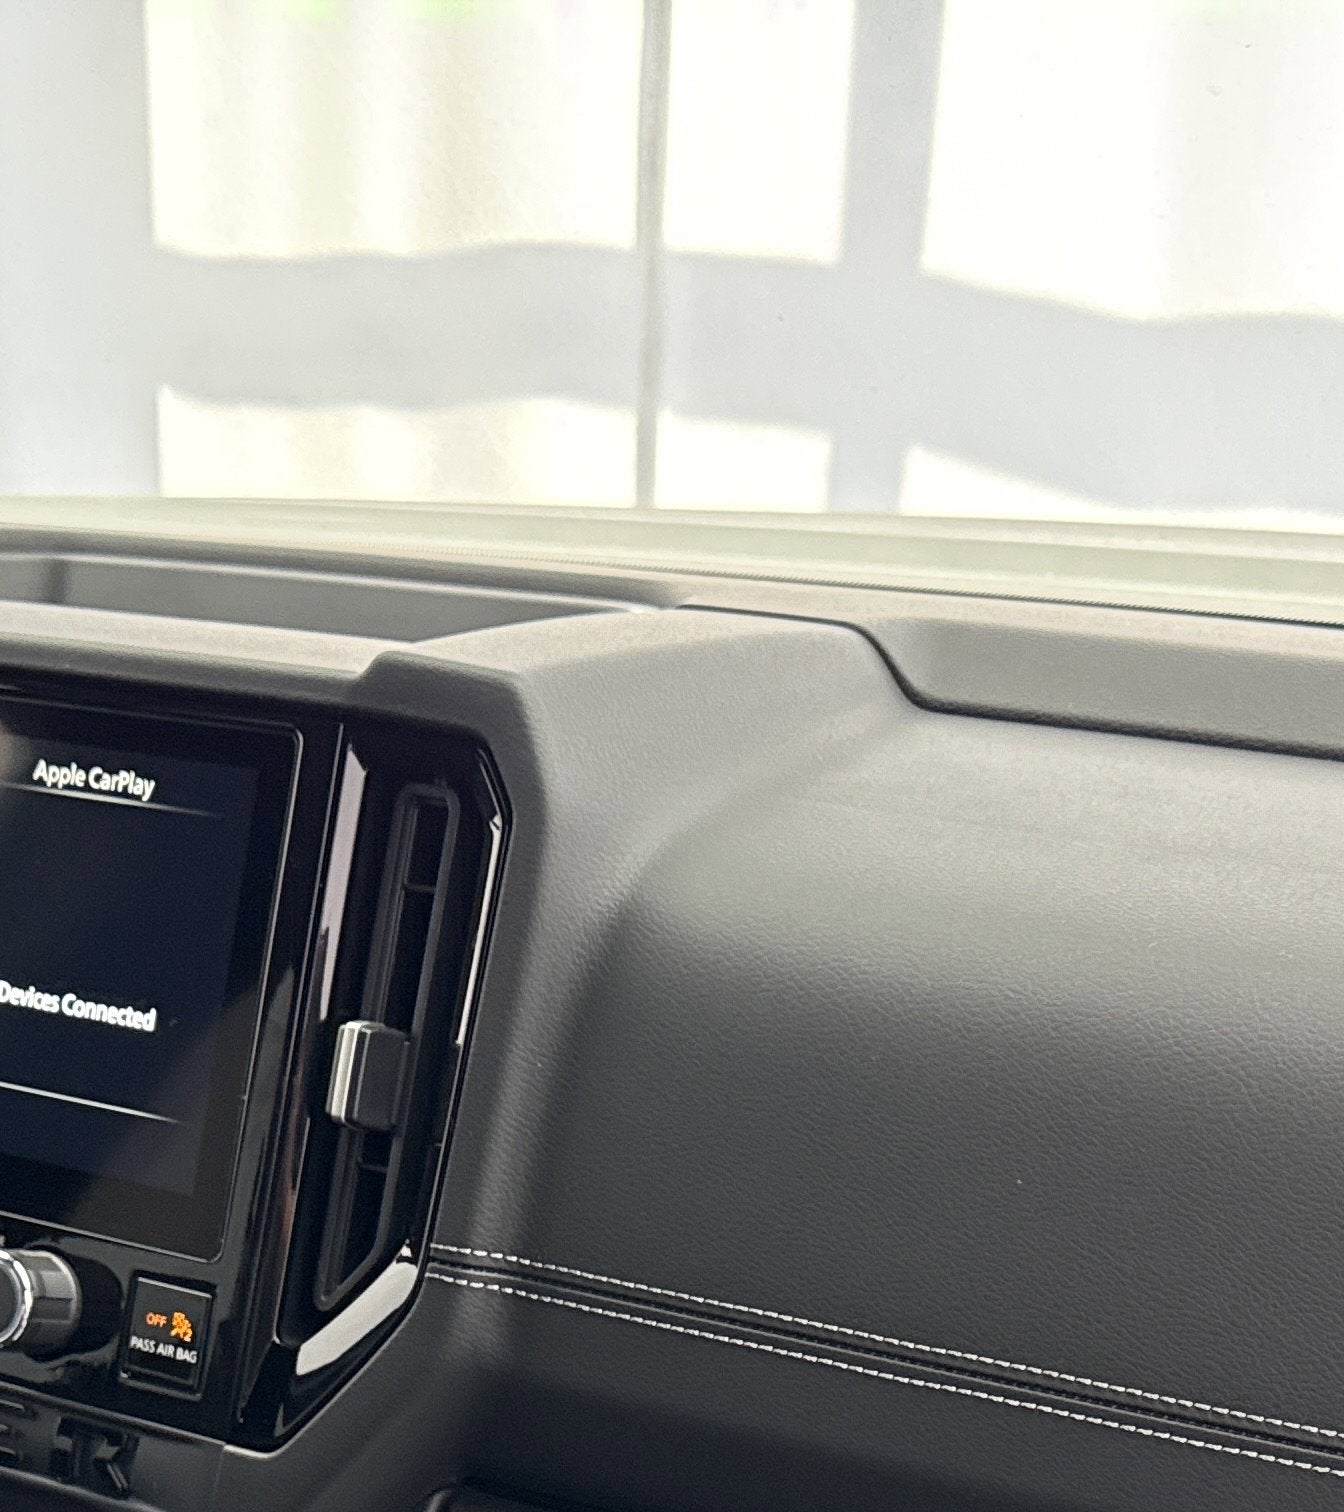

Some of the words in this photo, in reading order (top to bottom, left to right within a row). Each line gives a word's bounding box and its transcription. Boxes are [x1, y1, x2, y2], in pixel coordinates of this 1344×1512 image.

[32, 759, 86, 788] Apple
[88, 766, 155, 801] CarPlay
[61, 994, 156, 1032] Connected
[145, 1311, 168, 1328] OFF
[130, 1336, 155, 1355] PASS
[156, 1341, 174, 1358] AIR
[175, 1345, 198, 1364] BAG
